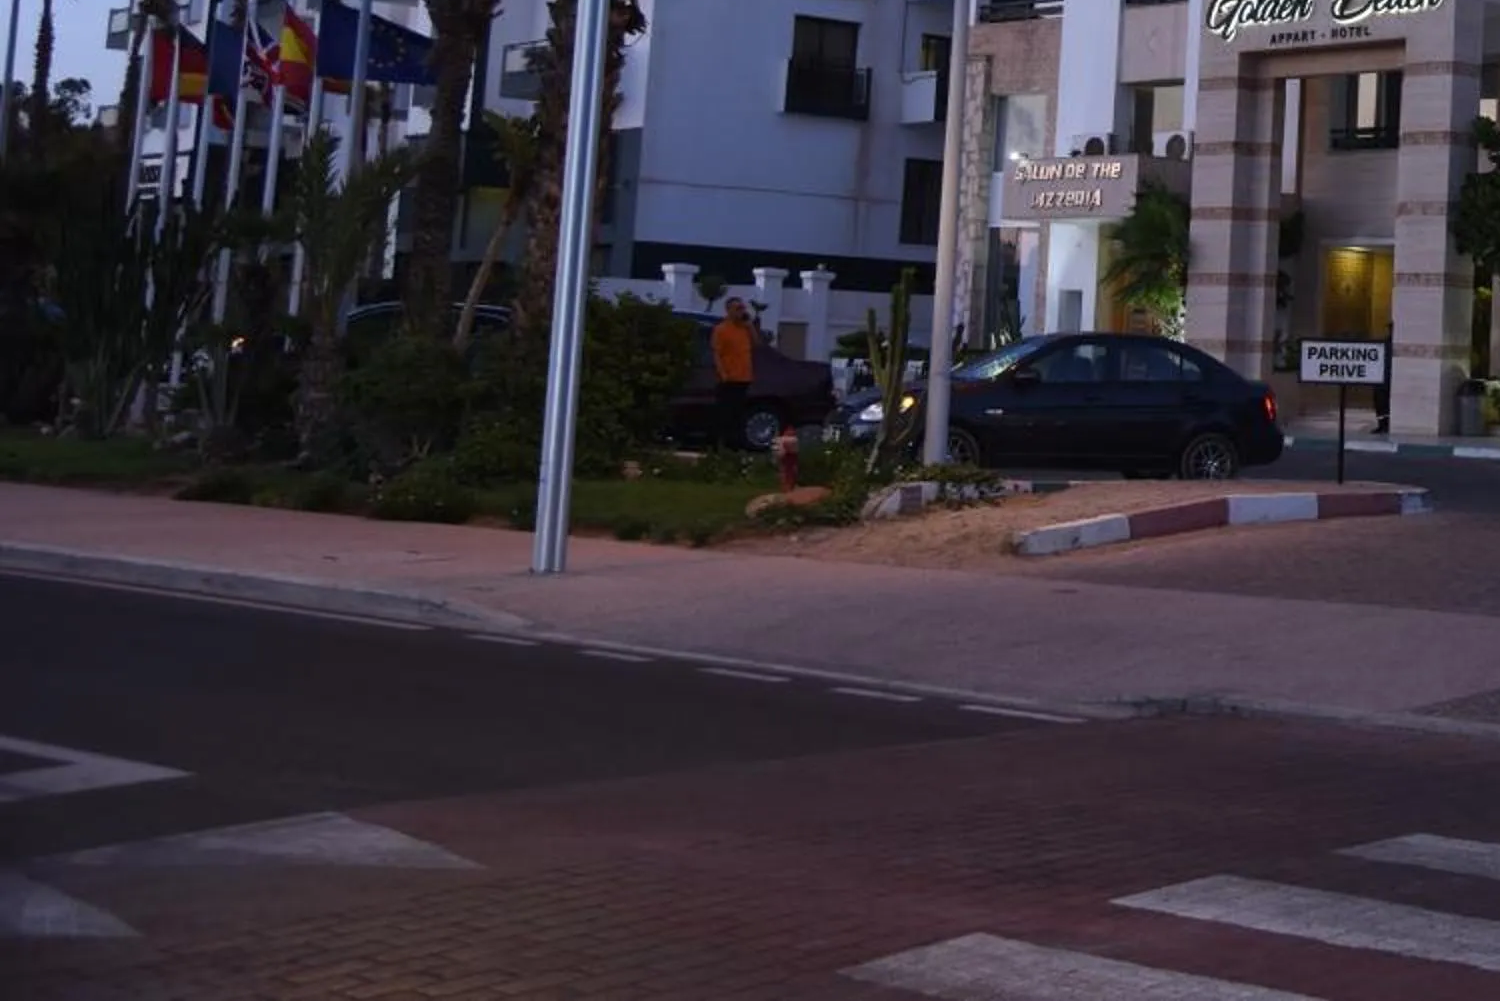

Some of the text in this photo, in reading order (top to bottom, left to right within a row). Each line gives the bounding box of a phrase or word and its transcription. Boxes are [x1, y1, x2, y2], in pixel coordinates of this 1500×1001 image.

[1269, 30, 1315, 45] APPART
[1331, 26, 1373, 40] HOTEL
[1307, 346, 1379, 361] PARKING
[1319, 363, 1367, 378] PRIVE
